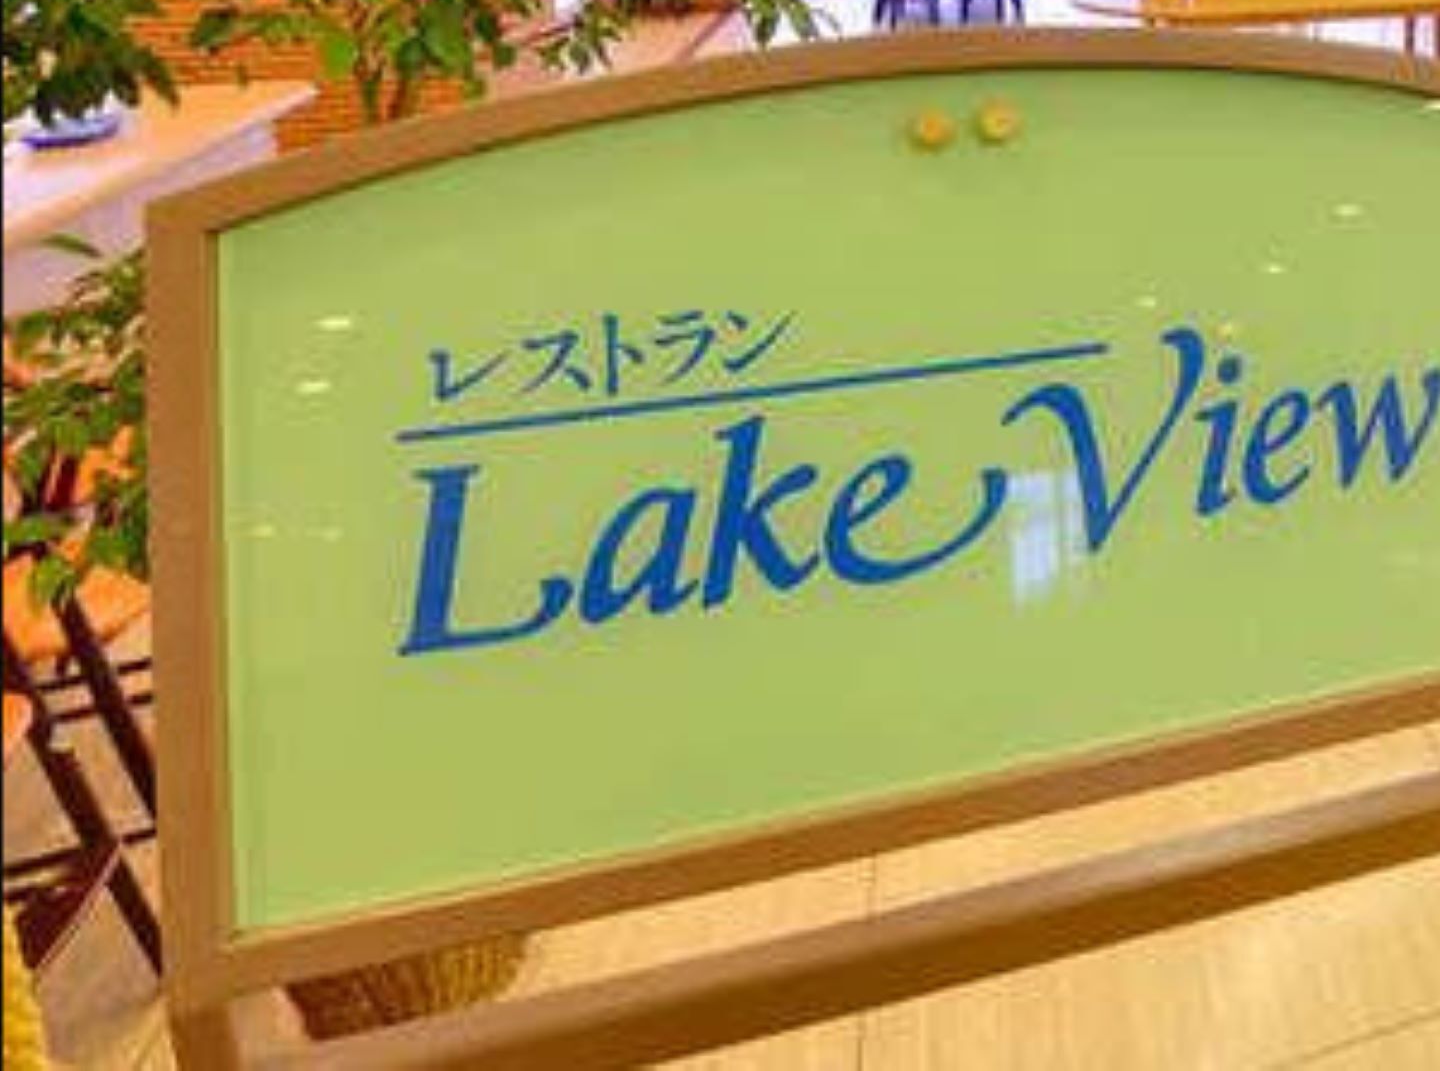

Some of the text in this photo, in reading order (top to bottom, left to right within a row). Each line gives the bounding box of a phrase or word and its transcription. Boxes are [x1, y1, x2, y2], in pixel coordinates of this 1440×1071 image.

[427, 310, 795, 403] レストラン
[399, 415, 1008, 657] Lake
